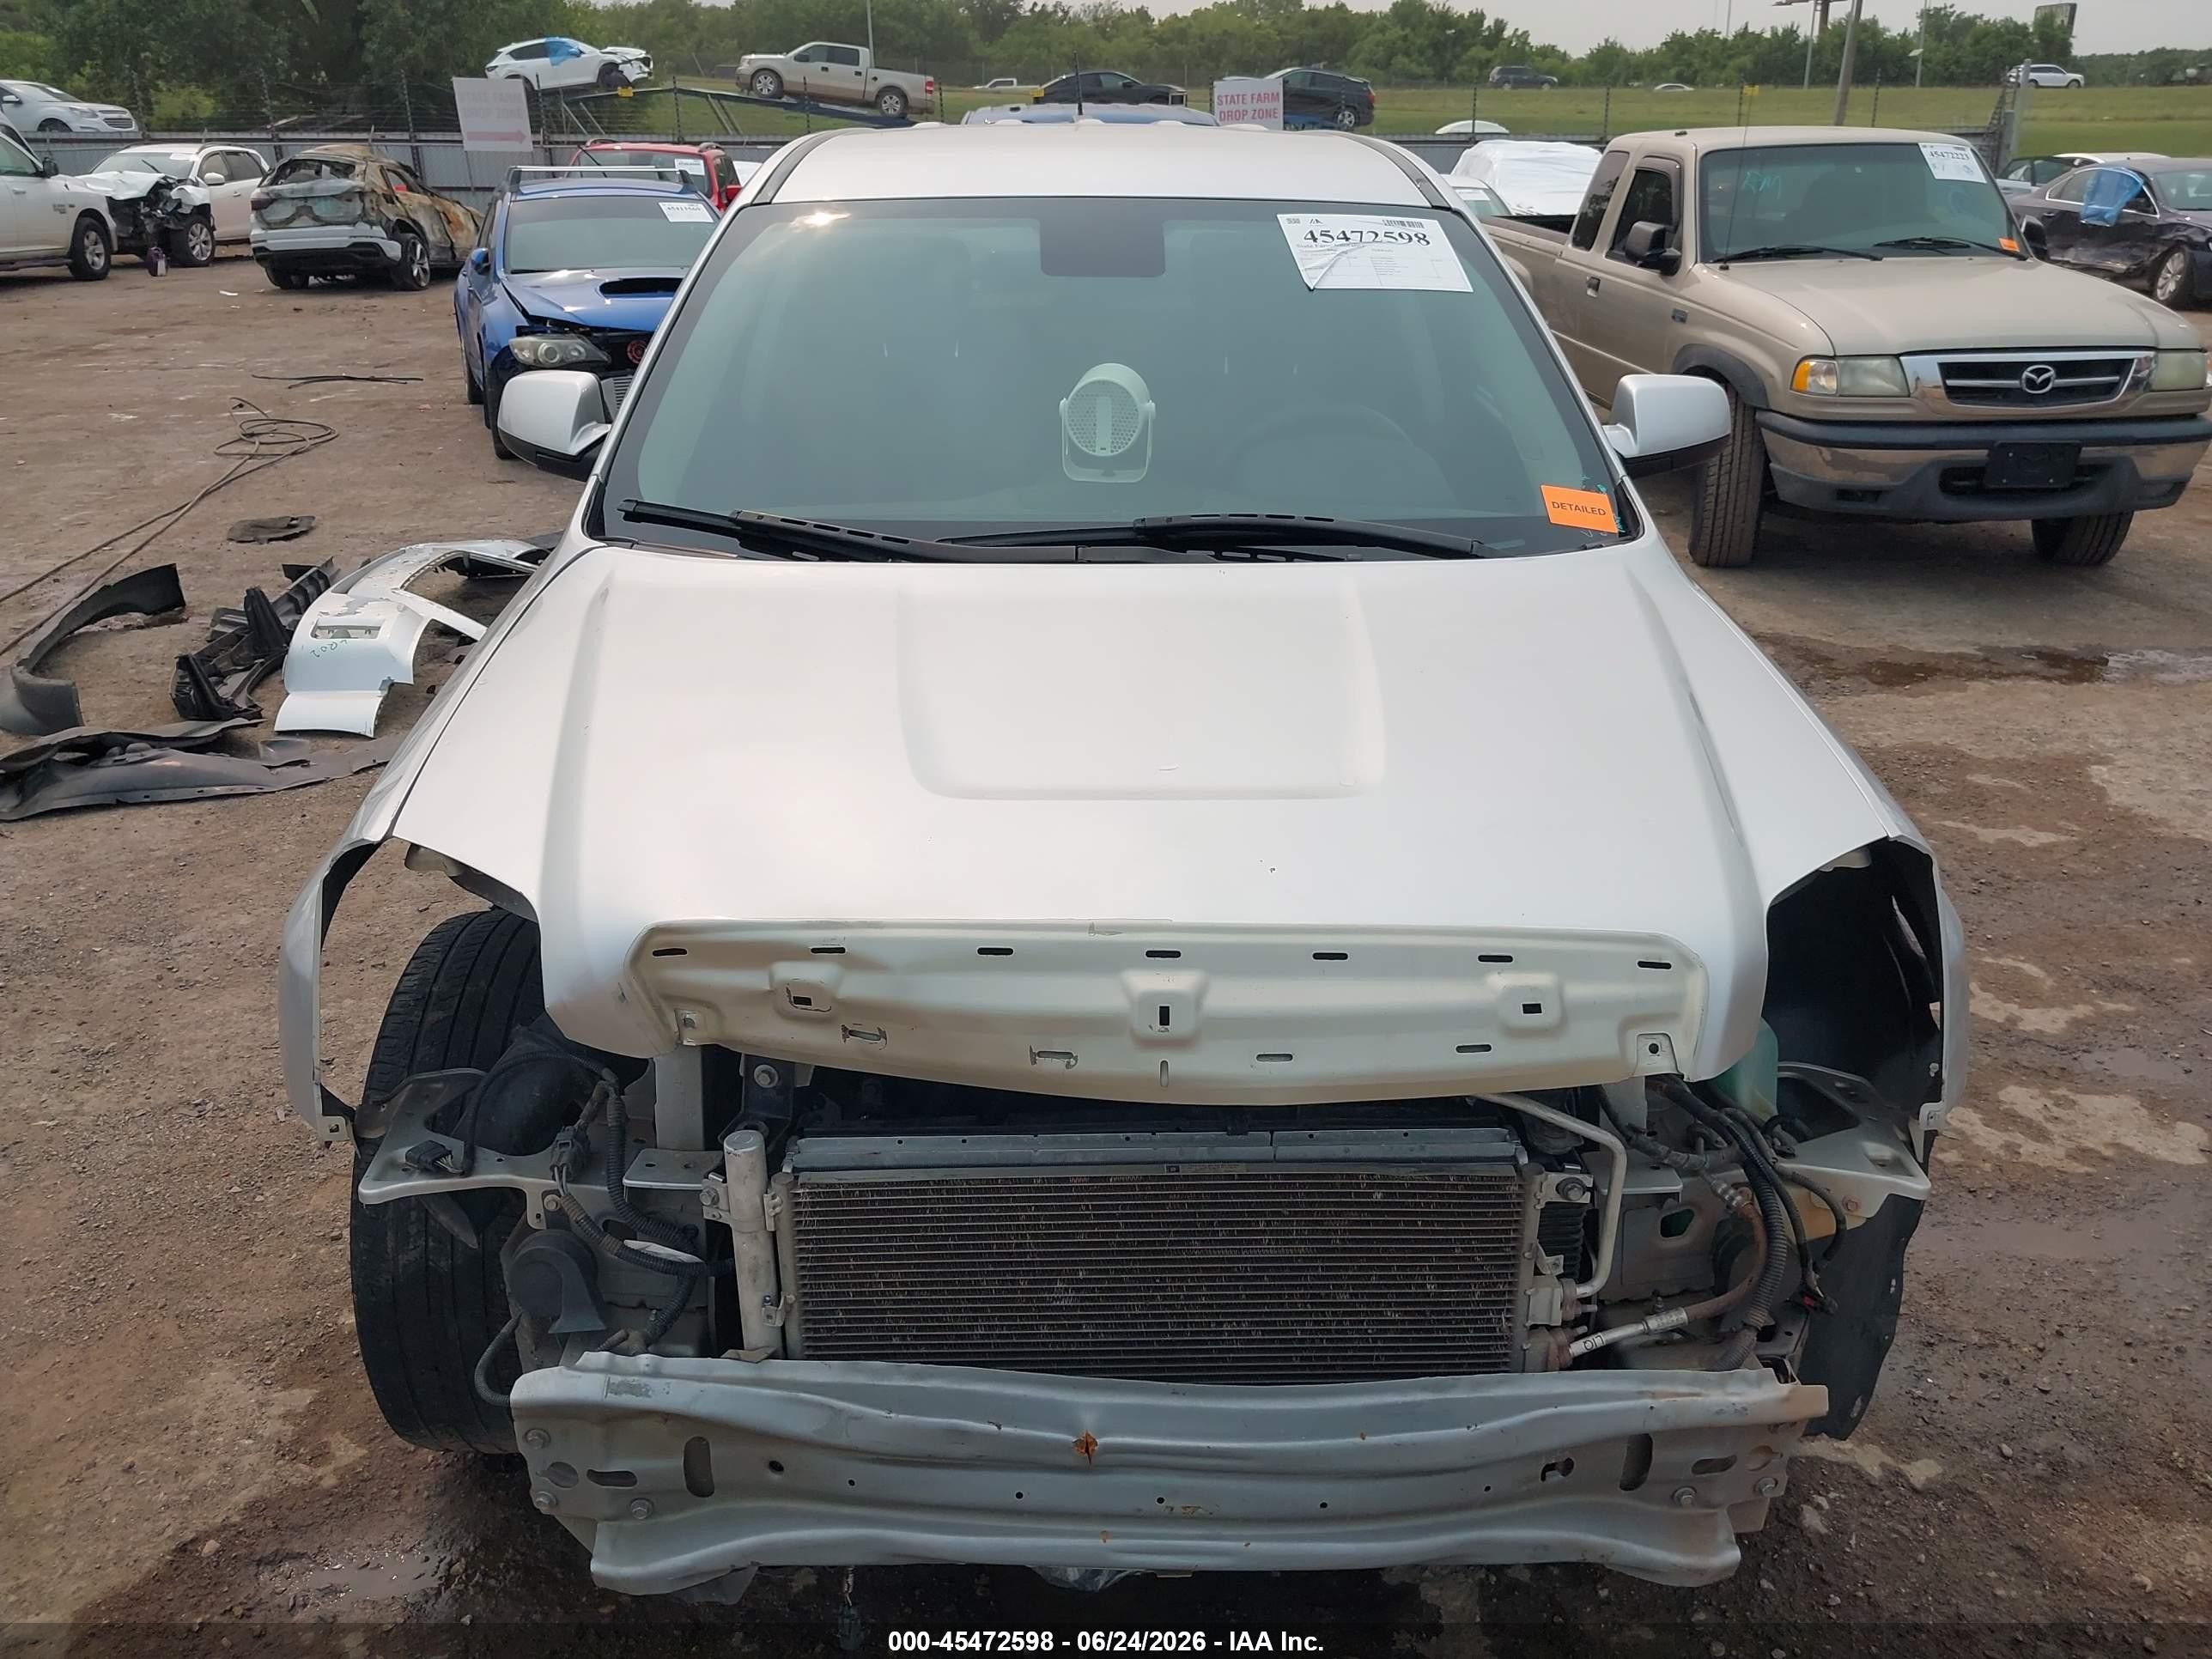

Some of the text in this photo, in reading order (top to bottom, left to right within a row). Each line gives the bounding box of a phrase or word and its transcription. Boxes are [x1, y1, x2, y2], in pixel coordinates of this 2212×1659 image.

[1217, 92, 1280, 106] STATE FARM
[1219, 108, 1279, 122] DROP ZONE
[1303, 229, 1431, 246] 45472598
[1551, 501, 1607, 516] DETAILED
[1583, 1334, 1605, 1351] LIQ
